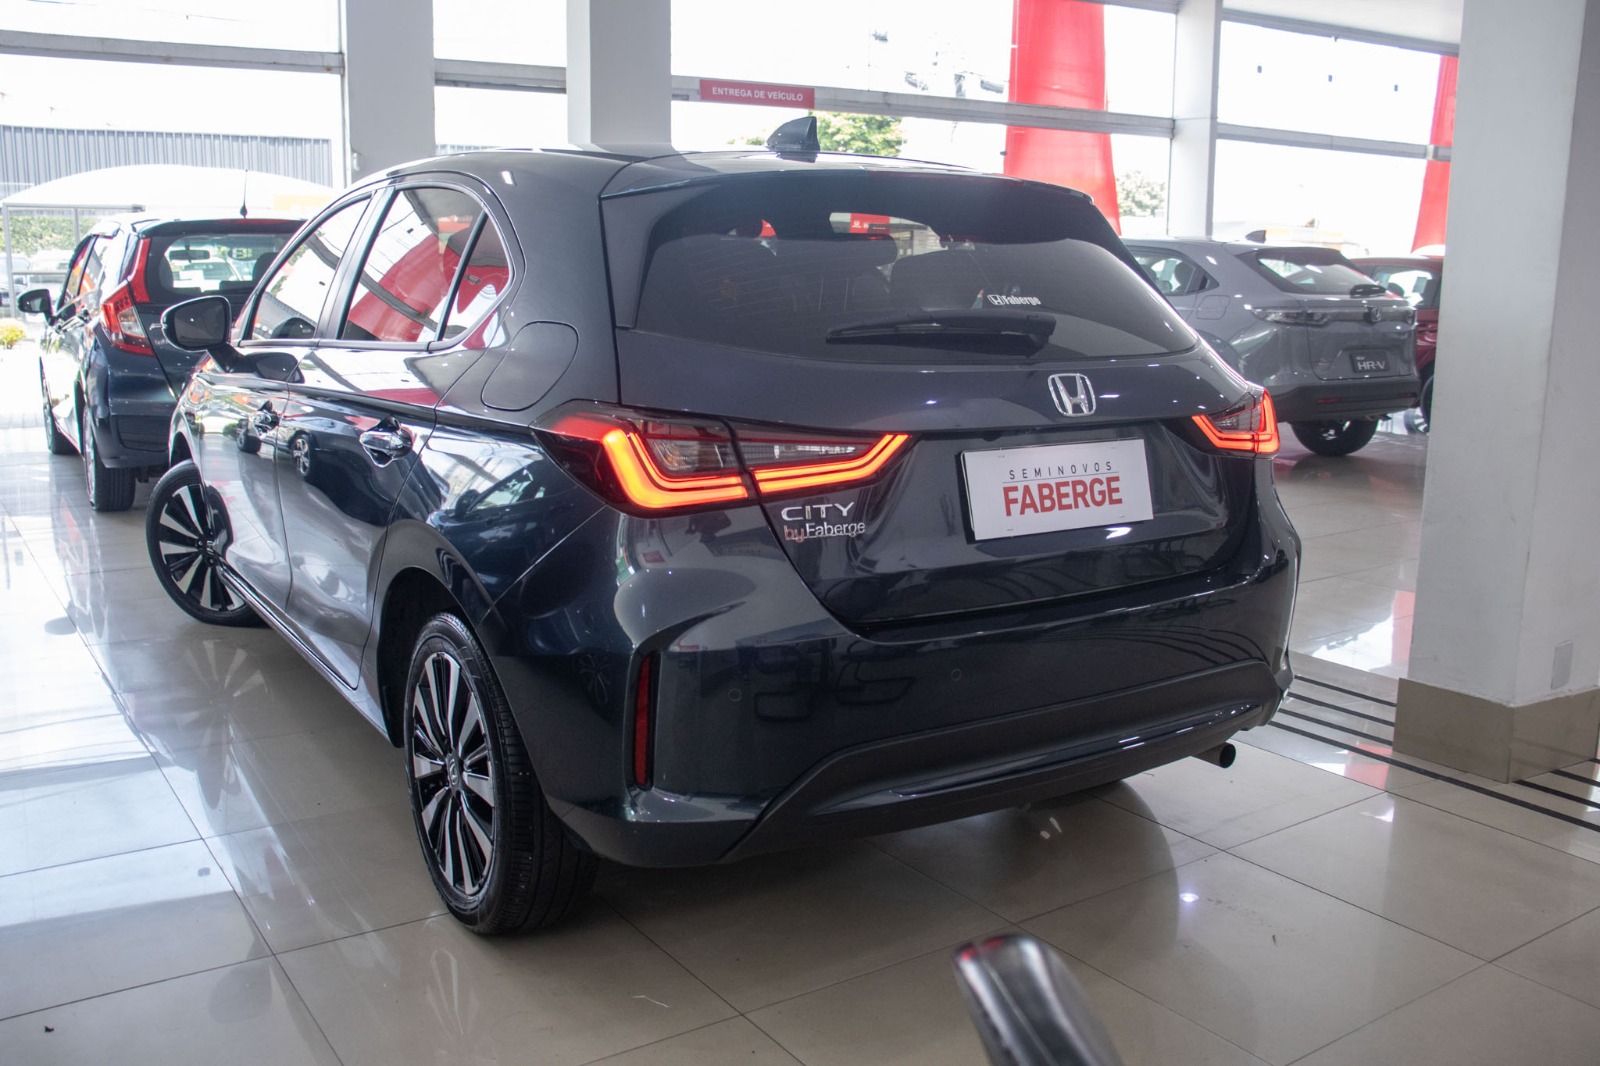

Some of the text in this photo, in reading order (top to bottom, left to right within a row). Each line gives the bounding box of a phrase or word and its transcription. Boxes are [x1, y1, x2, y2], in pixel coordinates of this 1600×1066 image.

[711, 86, 804, 102] ENTREGA DE VEÍCULO
[1008, 461, 1113, 480] SEMINOVOS
[1003, 475, 1123, 517] FABERGE
[781, 501, 855, 521] CITY
[805, 521, 866, 538] Faberge
